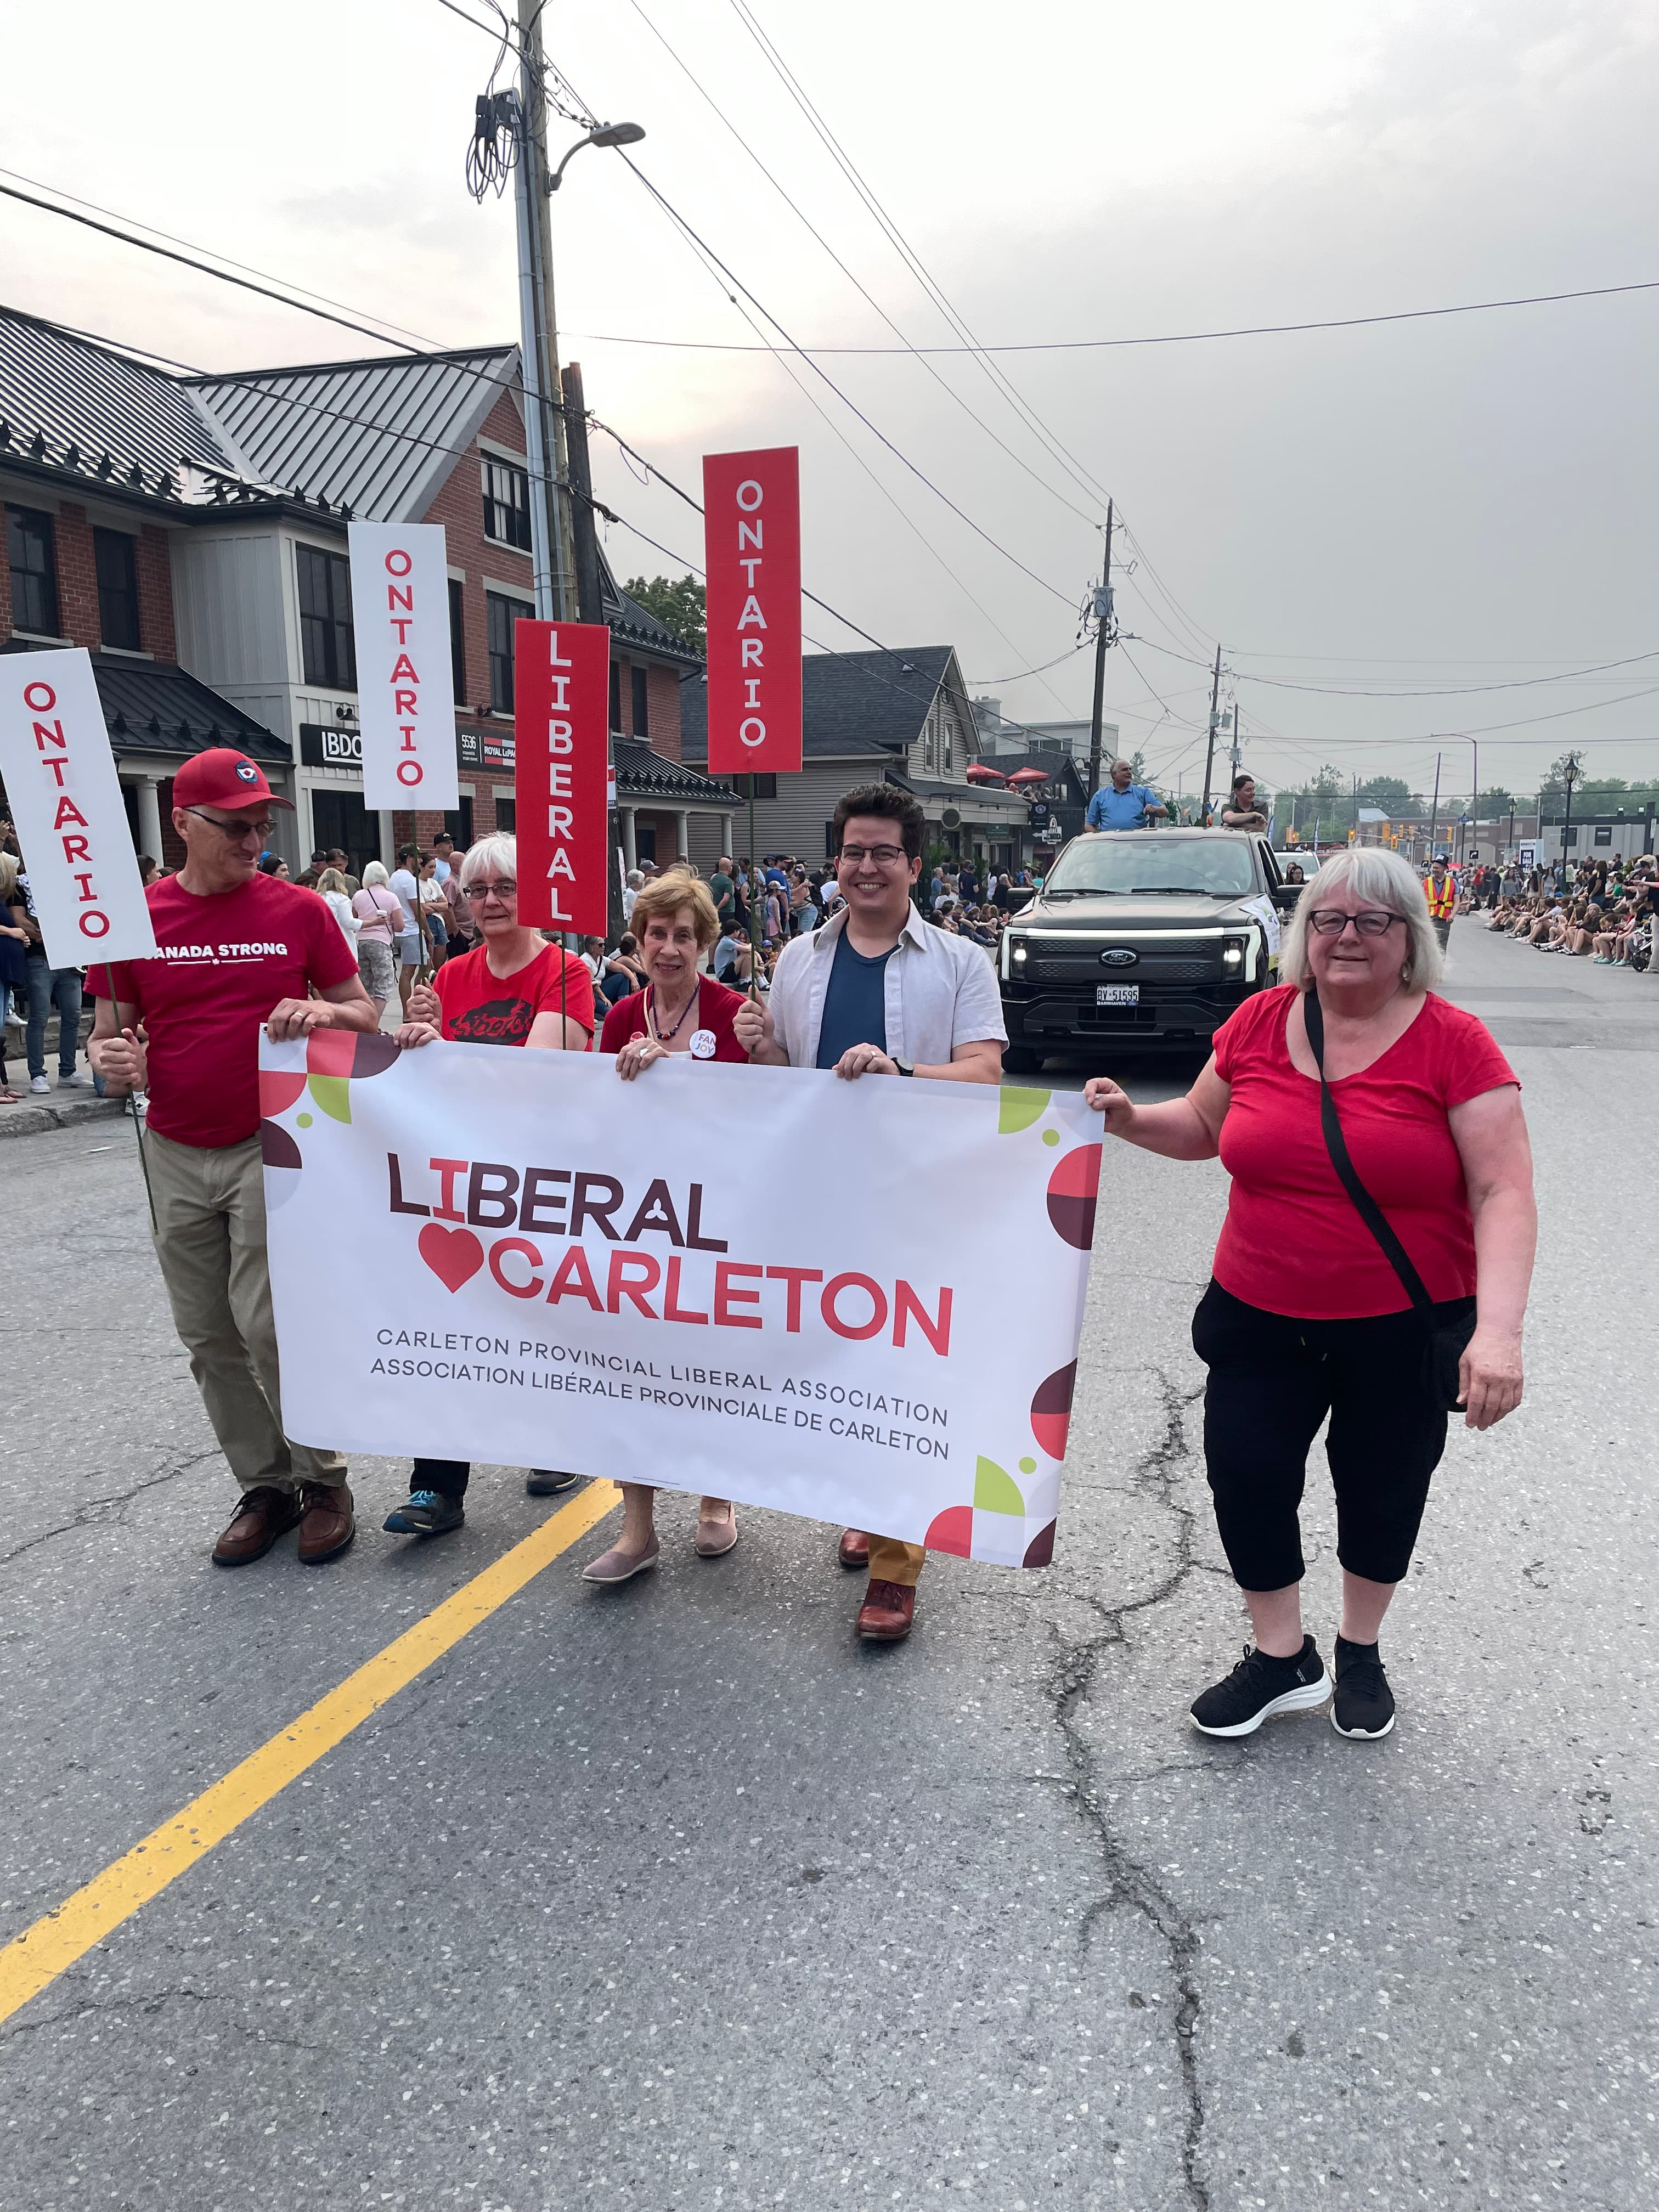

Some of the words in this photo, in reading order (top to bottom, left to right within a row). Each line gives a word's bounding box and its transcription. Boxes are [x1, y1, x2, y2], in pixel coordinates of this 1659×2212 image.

[736, 479, 768, 747] ONTARIO
[385, 549, 423, 786] ONTARIO
[461, 735, 476, 749] 5536
[484, 746, 502, 756] ROYAL
[546, 630, 576, 921] LIBERAL
[24, 681, 110, 938] ONTARIO
[145, 945, 215, 960] ANADA
[218, 943, 287, 956] STRONG
[1109, 953, 1128, 961] Ford
[1113, 990, 1138, 1001] 51595
[695, 1043, 714, 1054] JOY
[387, 1152, 728, 1253] LIBERAL
[488, 1237, 953, 1357] CARLETON
[370, 1358, 524, 1386] ASSOCIATION
[532, 1372, 633, 1400] LIBÉRALE
[640, 1386, 788, 1424] PROVINCIALE
[794, 1410, 822, 1431] DE
[829, 1418, 949, 1460] CARLETON
[376, 1329, 509, 1355] CARLETON
[520, 1341, 662, 1378] PROVINCIAL
[670, 1364, 772, 1391] LIBERAL
[781, 1378, 948, 1427] ASSOCIATION
